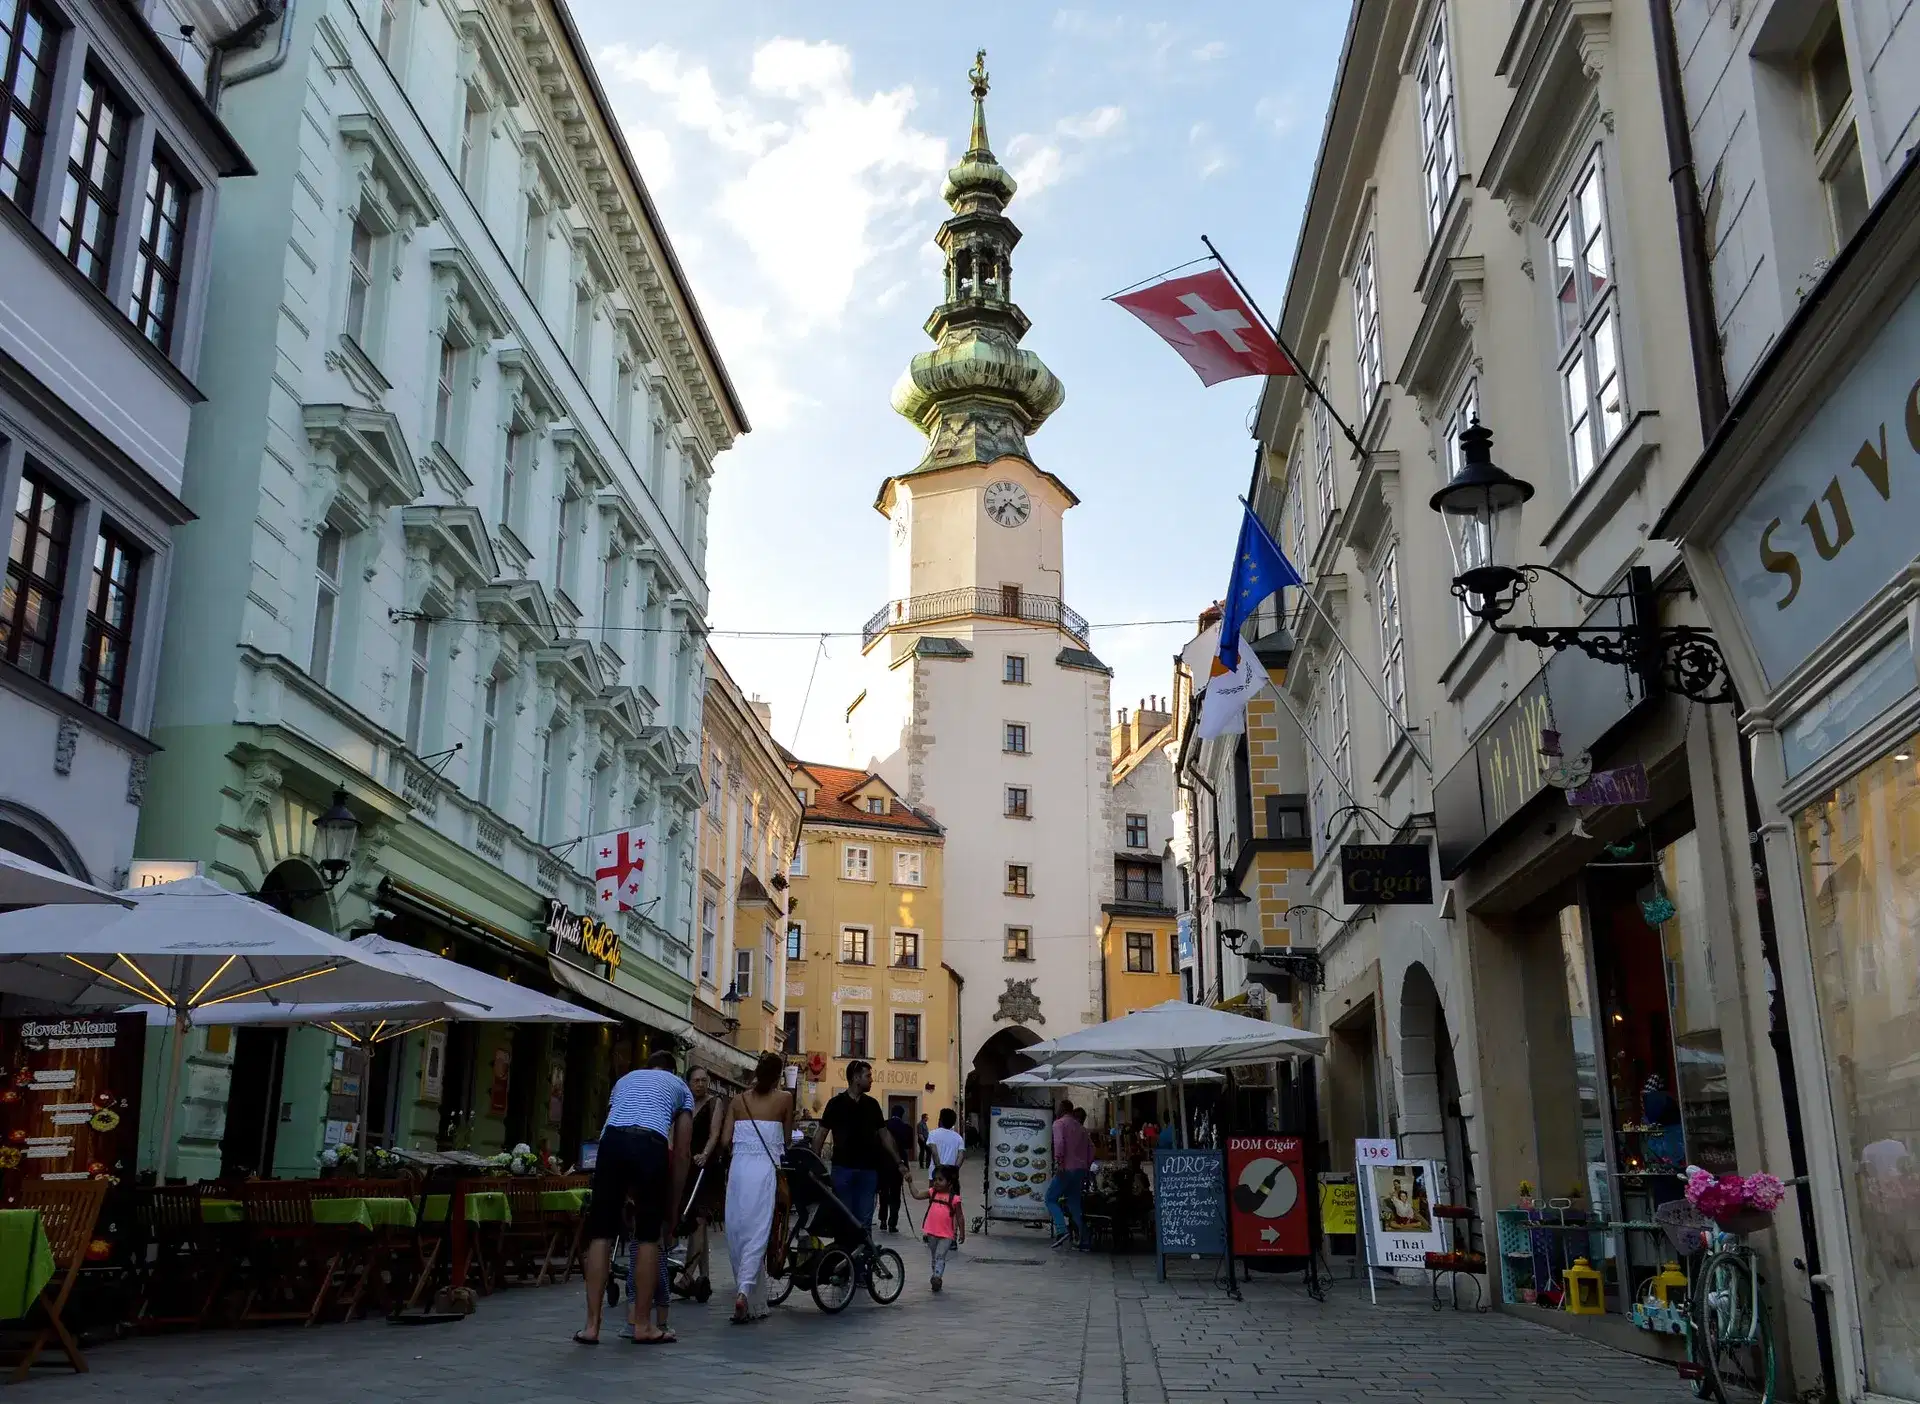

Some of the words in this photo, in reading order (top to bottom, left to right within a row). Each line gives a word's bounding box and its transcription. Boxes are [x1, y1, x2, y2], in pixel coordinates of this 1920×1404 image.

[1348, 868, 1428, 900] Cigár
[21, 1020, 71, 1037] Slovak
[72, 1020, 118, 1035] Menu
[1231, 1139, 1262, 1150] DOM
[1393, 1240, 1425, 1250] Thai
